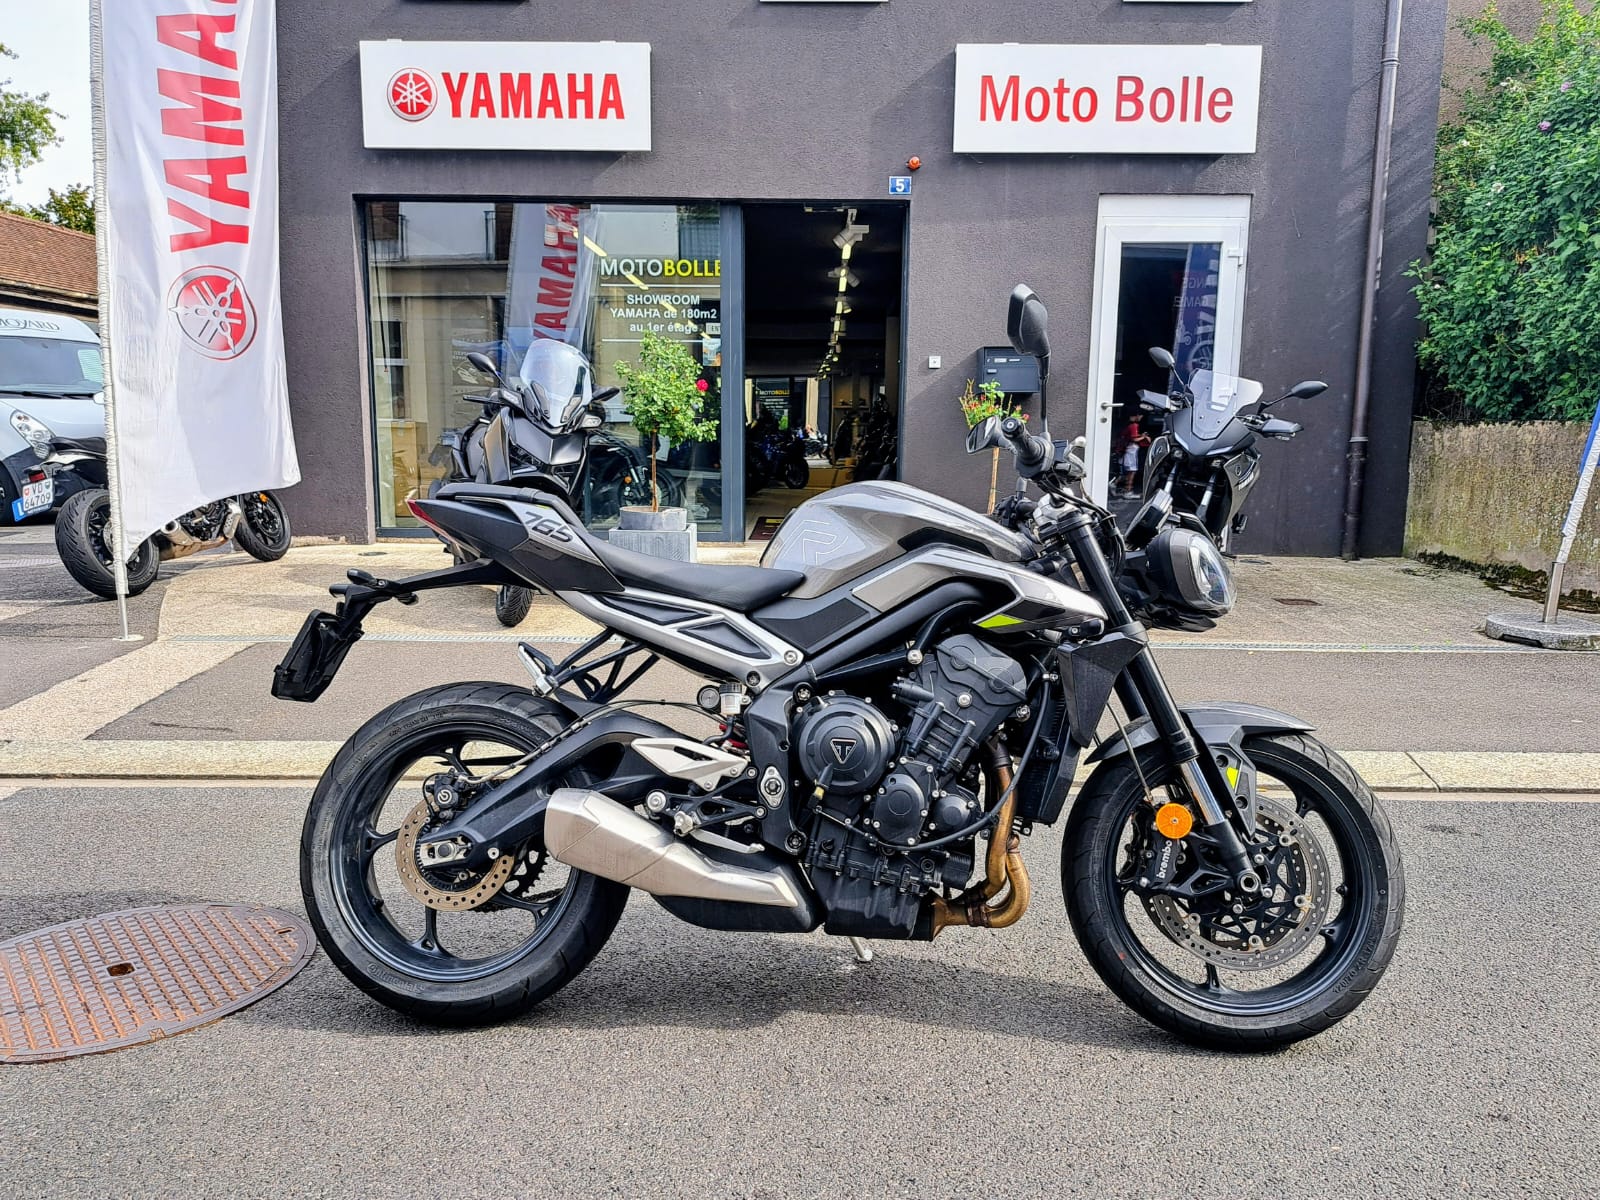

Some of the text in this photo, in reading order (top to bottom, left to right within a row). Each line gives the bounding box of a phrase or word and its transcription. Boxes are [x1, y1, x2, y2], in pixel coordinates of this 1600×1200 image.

[441, 72, 625, 120] YAMAHA
[979, 75, 1234, 123] Moto Bolle
[156, 0, 251, 253] YAMA
[895, 178, 905, 192] 5
[627, 294, 700, 305] SHOWROOM
[610, 307, 717, 319] YAMAHA de 180m2
[630, 321, 698, 334] au 1er étage
[31, 482, 43, 494] VD
[24, 492, 51, 509] 64709
[525, 511, 573, 543] 765
[1156, 840, 1173, 879] brembo
